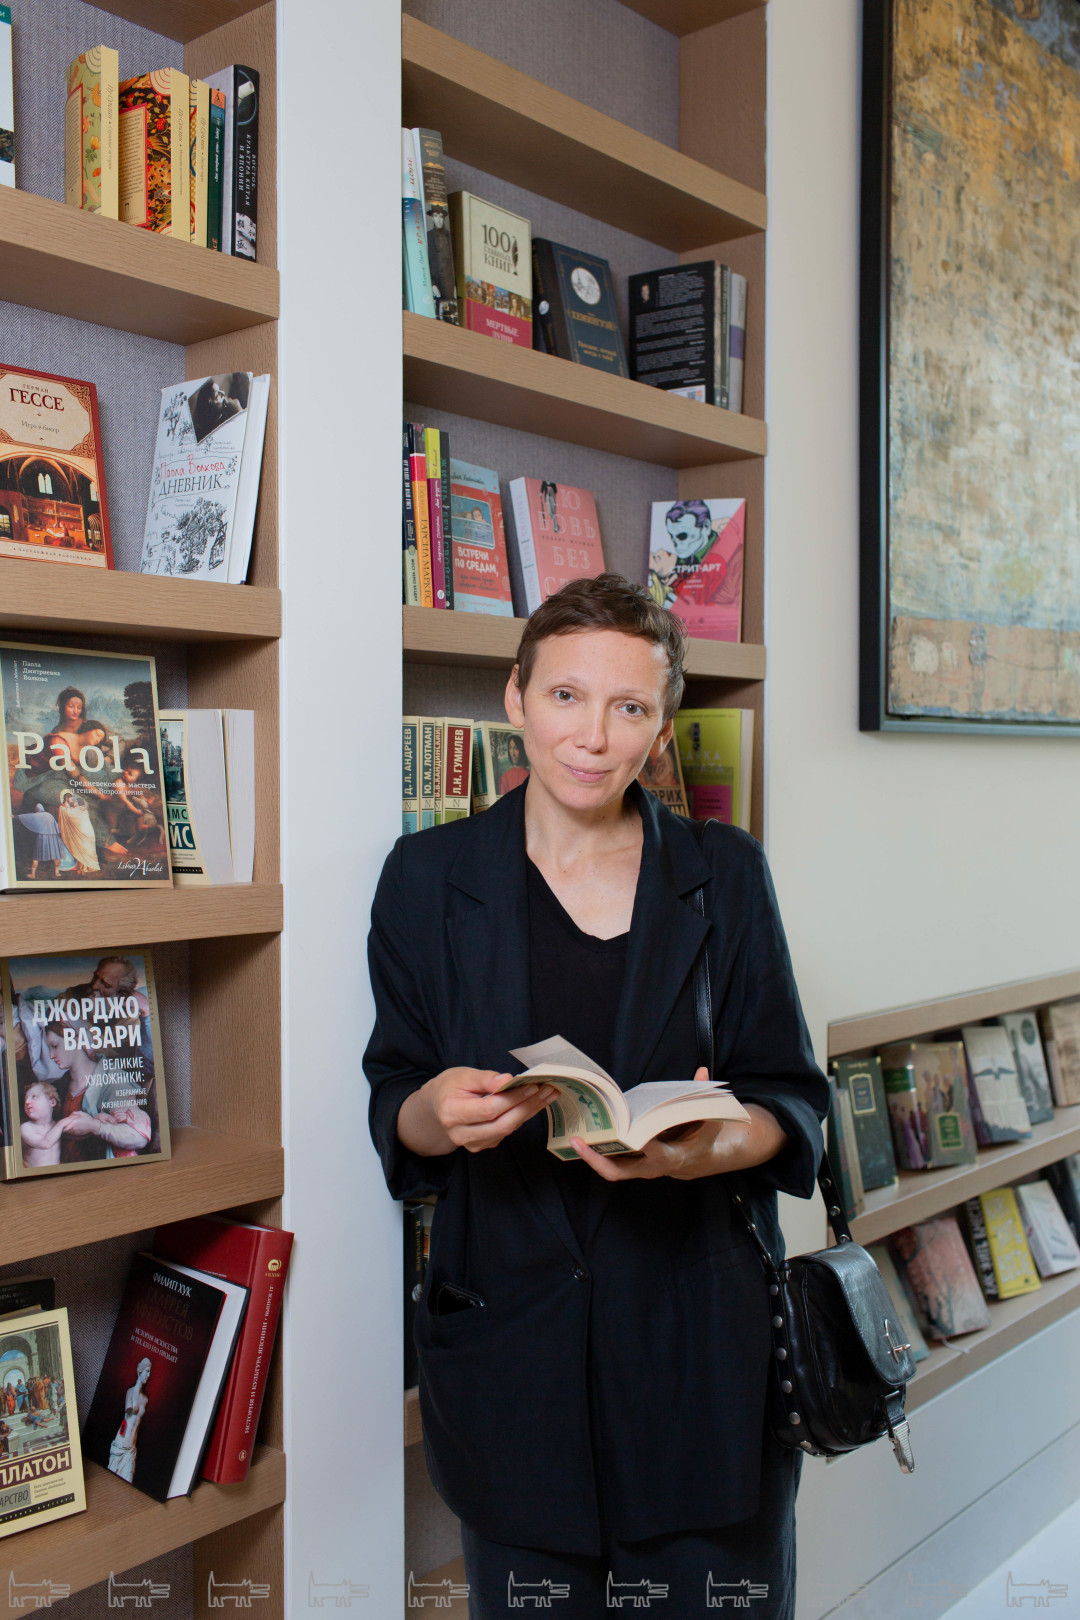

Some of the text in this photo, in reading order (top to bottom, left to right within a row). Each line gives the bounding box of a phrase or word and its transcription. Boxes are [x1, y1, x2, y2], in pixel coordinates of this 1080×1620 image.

[481, 224, 512, 253] 100
[484, 253, 512, 274] КНИГ
[485, 318, 520, 338] МЕРТВЫЕ
[9, 387, 65, 411] ГЕССЕ
[22, 384, 49, 393] ГЕРМАН
[21, 420, 37, 429] Игра
[43, 424, 60, 434] бисер
[160, 462, 185, 480] Паола
[187, 454, 226, 475] Волкова
[159, 474, 223, 497] ДНЕВНИК
[537, 511, 596, 539] БОВЬ
[421, 519, 429, 559] ГАРСИА
[457, 546, 489, 561] ВСТРЕЧИ
[552, 546, 591, 570] БЕЗ
[454, 558, 499, 578] ПО СРЕДАМ,
[422, 560, 431, 603] МАРКЕС
[22, 660, 42, 668] Паола
[22, 668, 61, 676] Дмитриевна
[13, 731, 155, 775] Paola
[403, 727, 413, 796] Д. Л. АНДРЕЕВ
[423, 726, 432, 795] Ю. М. ЛОТМАН
[452, 729, 464, 795] Л.Н. ГУМИЛЕВ
[69, 779, 156, 790] Средневековые мастера
[99, 787, 144, 797] Возрождения
[32, 995, 141, 1026] ДЖОРДЖО
[63, 1024, 142, 1051] ВАЗАРИ
[102, 1057, 144, 1071] ВЕЛИКИЕ
[84, 1071, 146, 1087] ХУДОЖНИКИ:
[101, 1098, 148, 1109] ЖИЗНЕОПИСАНИЯ
[115, 1088, 147, 1097] ИЗБРАННЫЕ
[152, 1272, 178, 1292] ФИЛИП
[178, 1282, 193, 1298] ХУК
[244, 1397, 255, 1434] ИСТОРИЯ
[251, 1355, 262, 1391] КУЛЬТУРА
[257, 1322, 268, 1354] ЯПОНИИ
